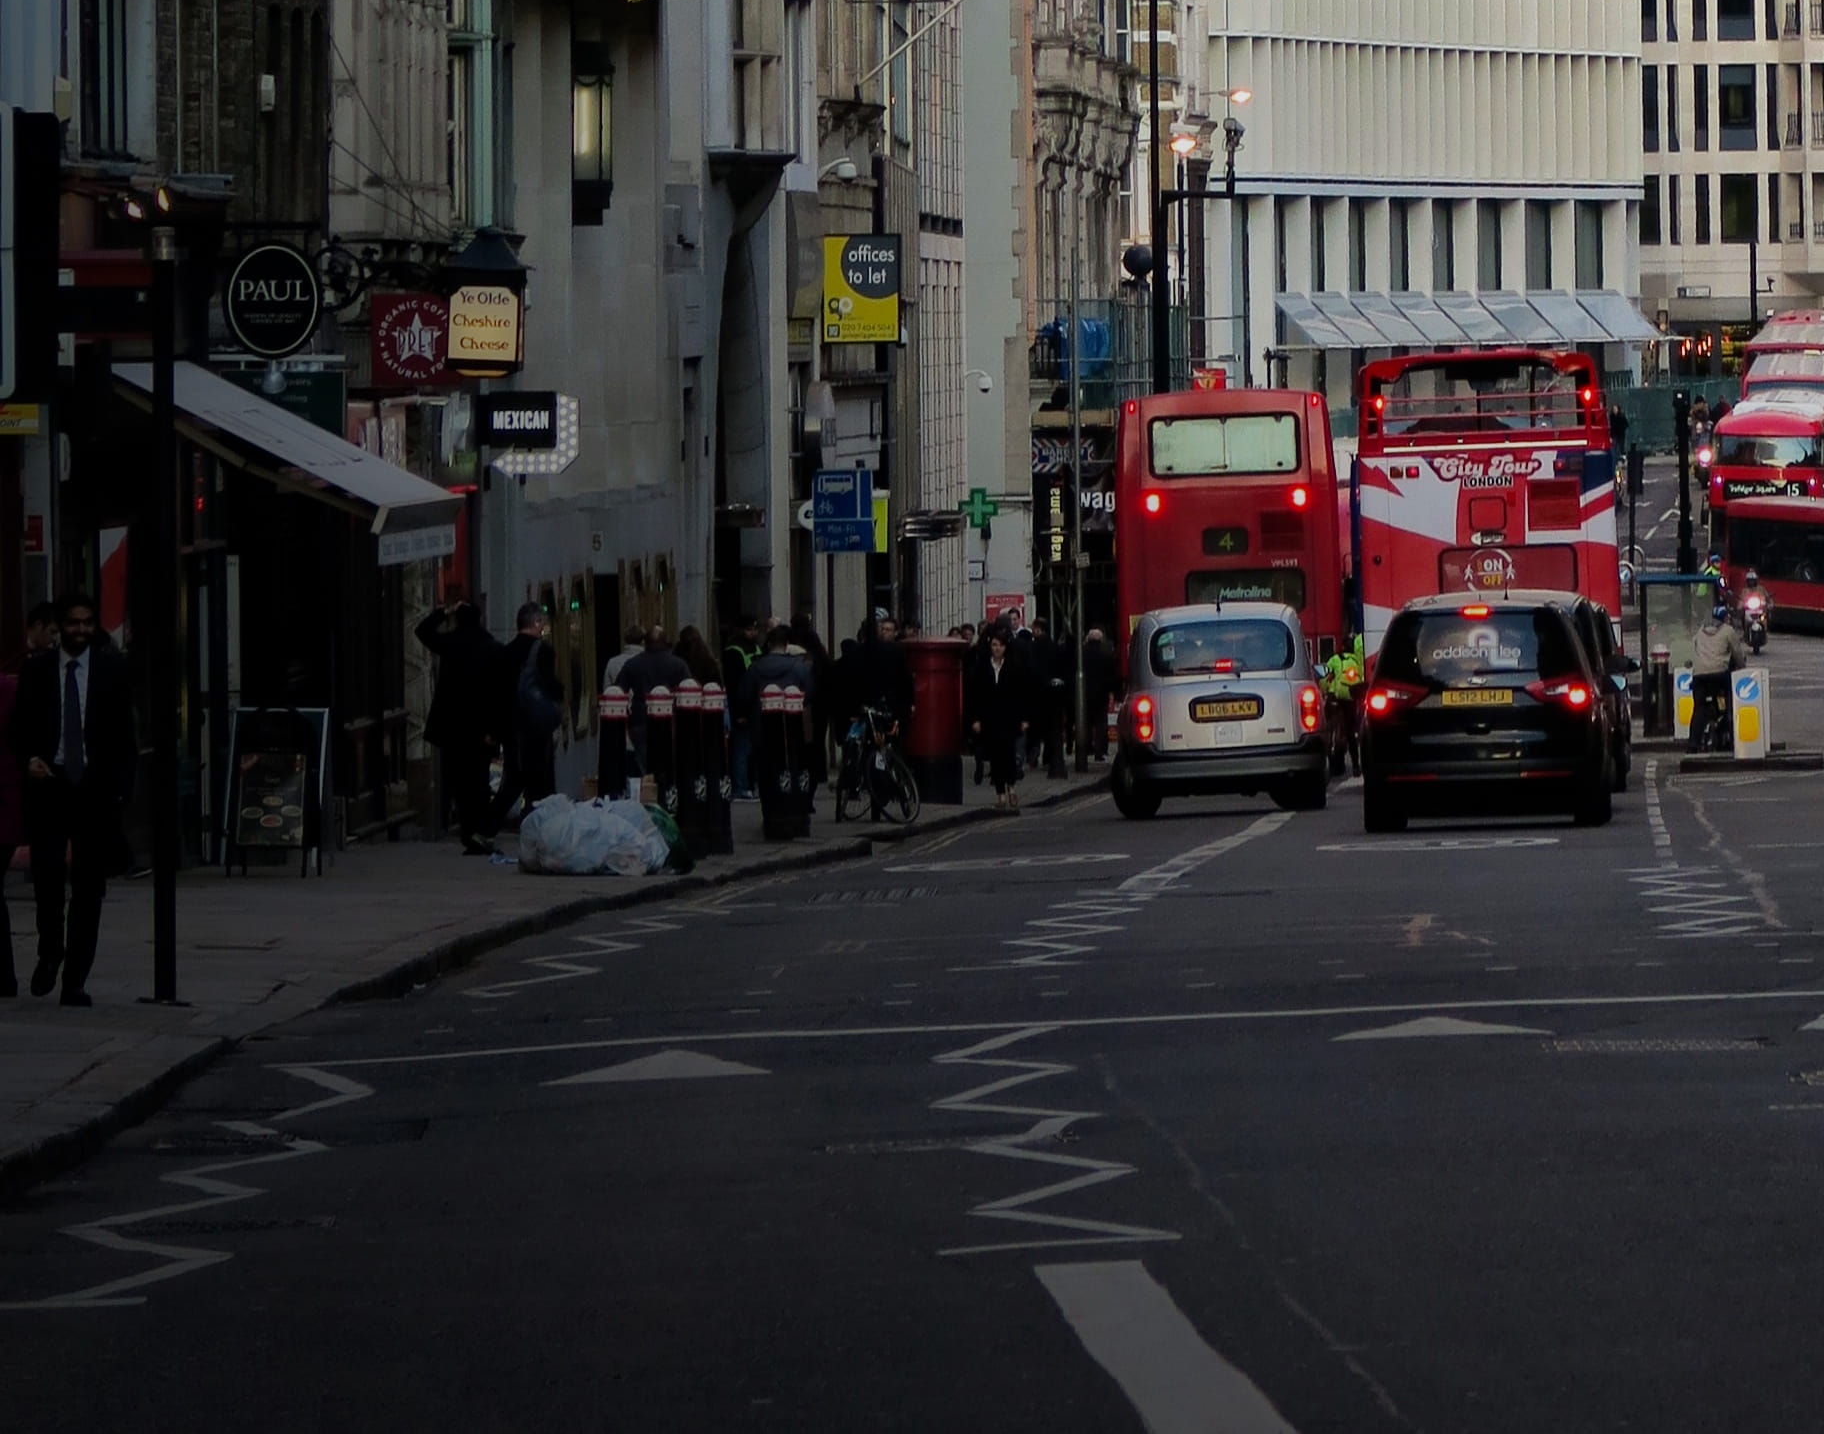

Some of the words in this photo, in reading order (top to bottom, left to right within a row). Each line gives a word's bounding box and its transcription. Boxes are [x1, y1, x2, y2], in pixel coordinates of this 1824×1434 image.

[848, 244, 895, 262] offices
[848, 269, 863, 284] to
[868, 266, 886, 284] let
[238, 279, 311, 302] PAUL
[460, 291, 475, 305] Ye
[477, 291, 509, 305] Olde
[378, 299, 419, 337] ORGANIC
[453, 313, 510, 328] Cheshire
[396, 325, 439, 356] PRET
[460, 337, 509, 351] Cheese
[381, 350, 428, 379] NATURAL
[492, 410, 550, 430] MEXICAN
[1433, 456, 1485, 480] City
[1486, 453, 1540, 476] Tour
[1464, 476, 1512, 488] LONDON
[1786, 483, 1800, 497] 15
[592, 534, 601, 551] 5
[1217, 531, 1234, 551] 4
[1432, 644, 1488, 660] addison
